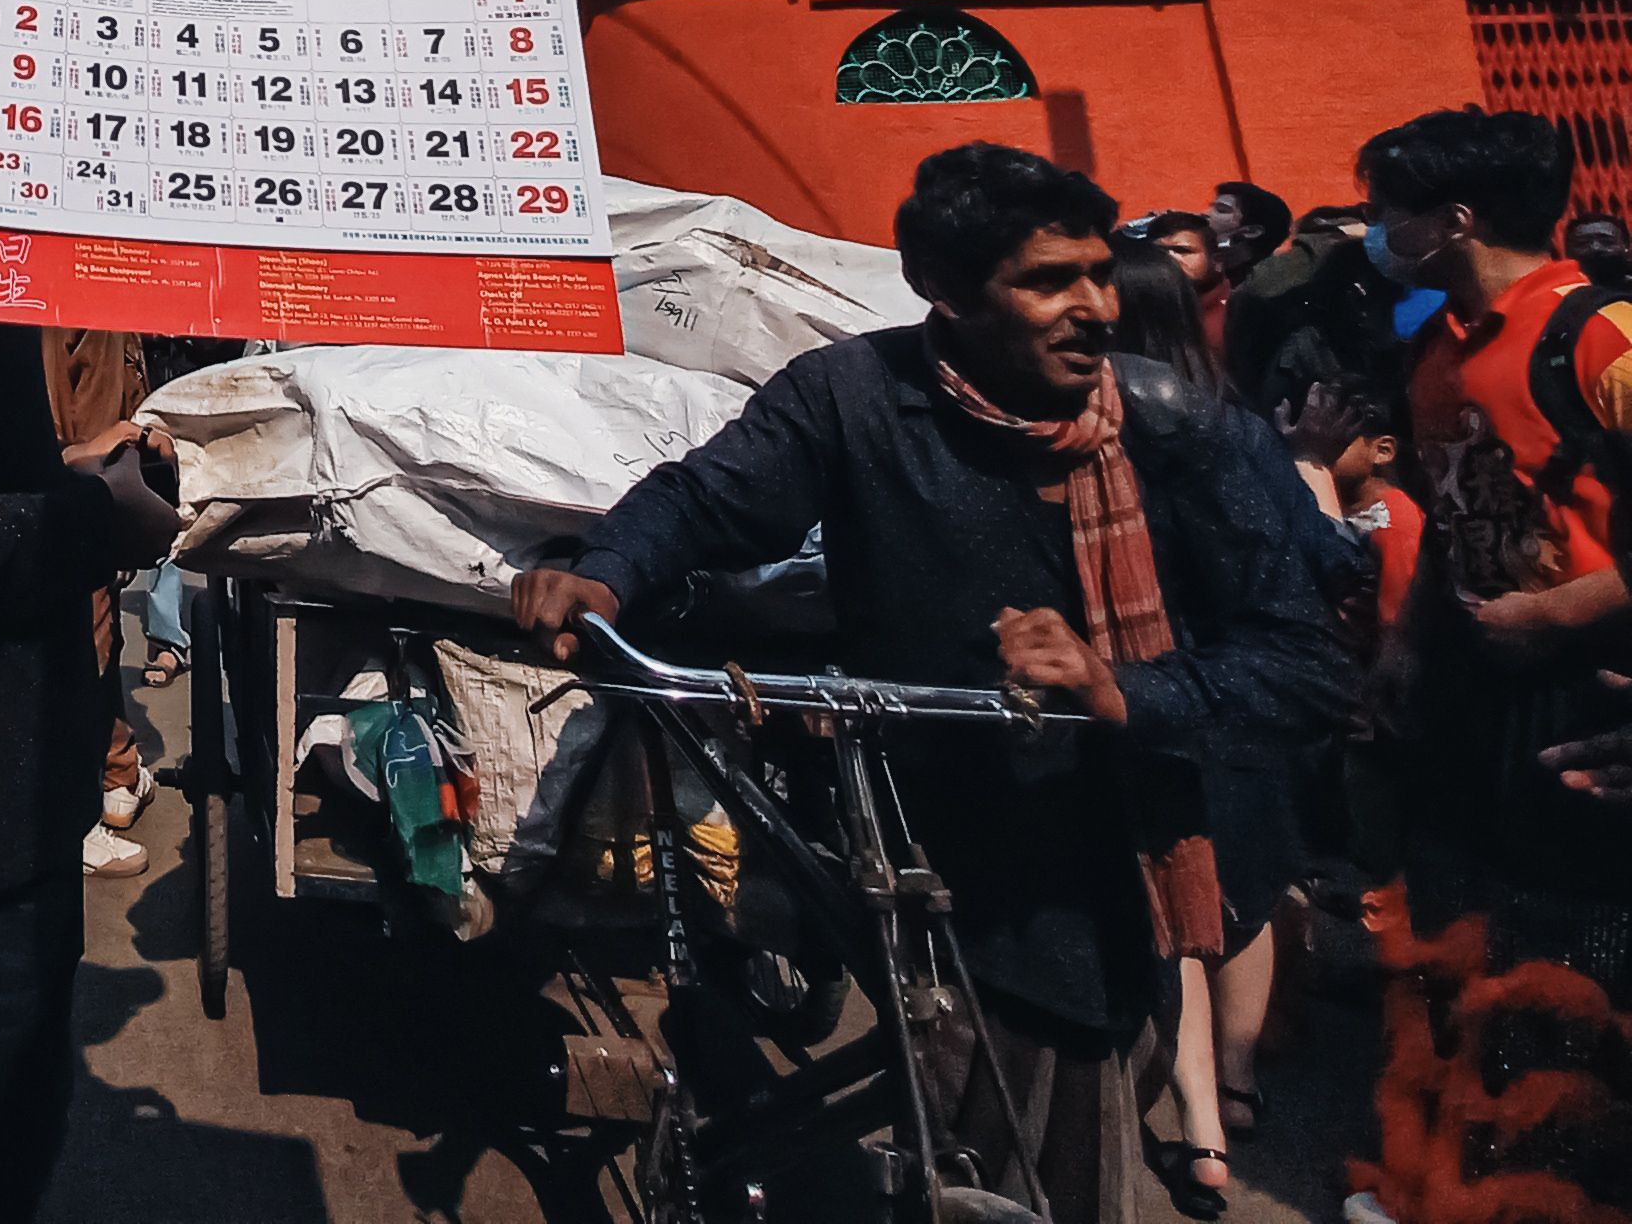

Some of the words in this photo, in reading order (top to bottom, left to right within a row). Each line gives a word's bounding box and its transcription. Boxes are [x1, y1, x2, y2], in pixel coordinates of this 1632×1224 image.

[15, 6, 38, 32] 2
[96, 15, 119, 41] 3
[176, 23, 199, 49] 4
[259, 27, 280, 53] 5
[340, 29, 363, 54] 6
[423, 28, 445, 55] 7
[511, 27, 533, 53] 8
[13, 54, 36, 80] 9
[86, 62, 128, 91] 10
[172, 70, 207, 98] 11
[251, 75, 293, 102] 12
[335, 78, 376, 104] 13
[419, 78, 463, 106] 14
[506, 78, 549, 105] 15
[2, 104, 42, 132] 16
[86, 112, 127, 142] 17
[170, 120, 211, 148] 18
[254, 125, 295, 153] 19
[336, 128, 384, 156] 20
[425, 130, 470, 158] 21
[511, 131, 561, 159] 22
[20, 182, 48, 199] 30
[107, 189, 133, 208] 31
[76, 160, 107, 179] 24
[168, 172, 216, 202] 25
[254, 177, 303, 206] 26
[341, 181, 389, 210] 27
[427, 183, 479, 213] 28
[517, 186, 569, 214] 29
